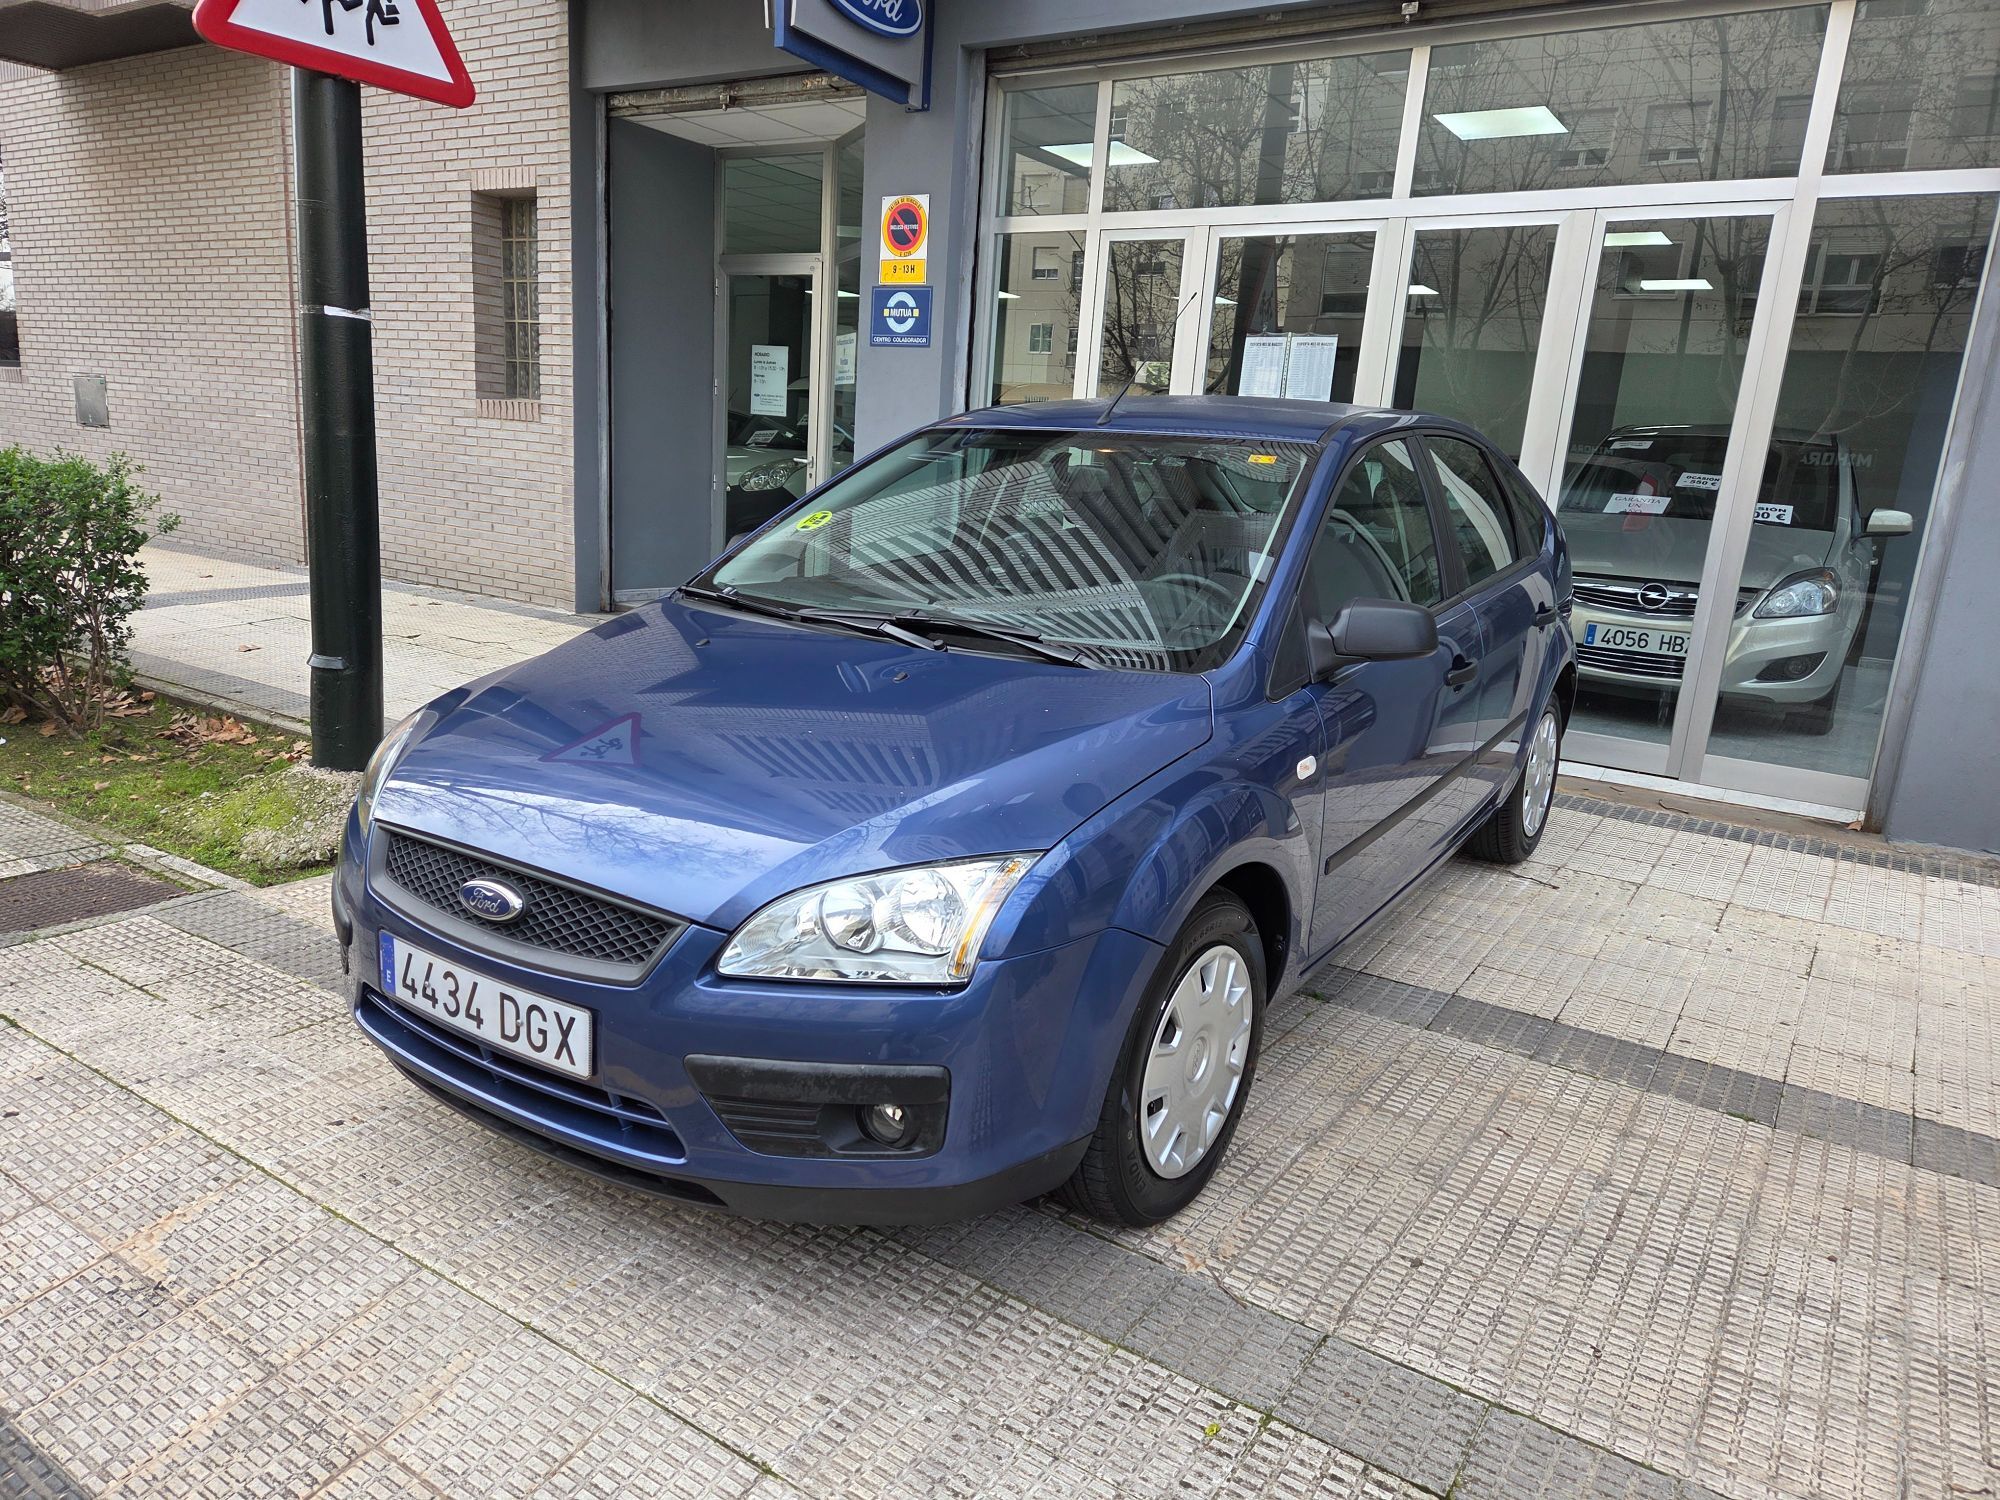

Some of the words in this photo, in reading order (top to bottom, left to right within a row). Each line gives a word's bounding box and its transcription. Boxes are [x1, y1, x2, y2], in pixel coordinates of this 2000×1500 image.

[889, 308, 912, 317] MUTUA
[1776, 513, 1785, 521] €
[1601, 628, 1650, 649] 4056
[469, 887, 501, 913] Ford
[386, 969, 392, 983] E
[402, 952, 484, 1030] 4434
[499, 992, 576, 1066] DGX
